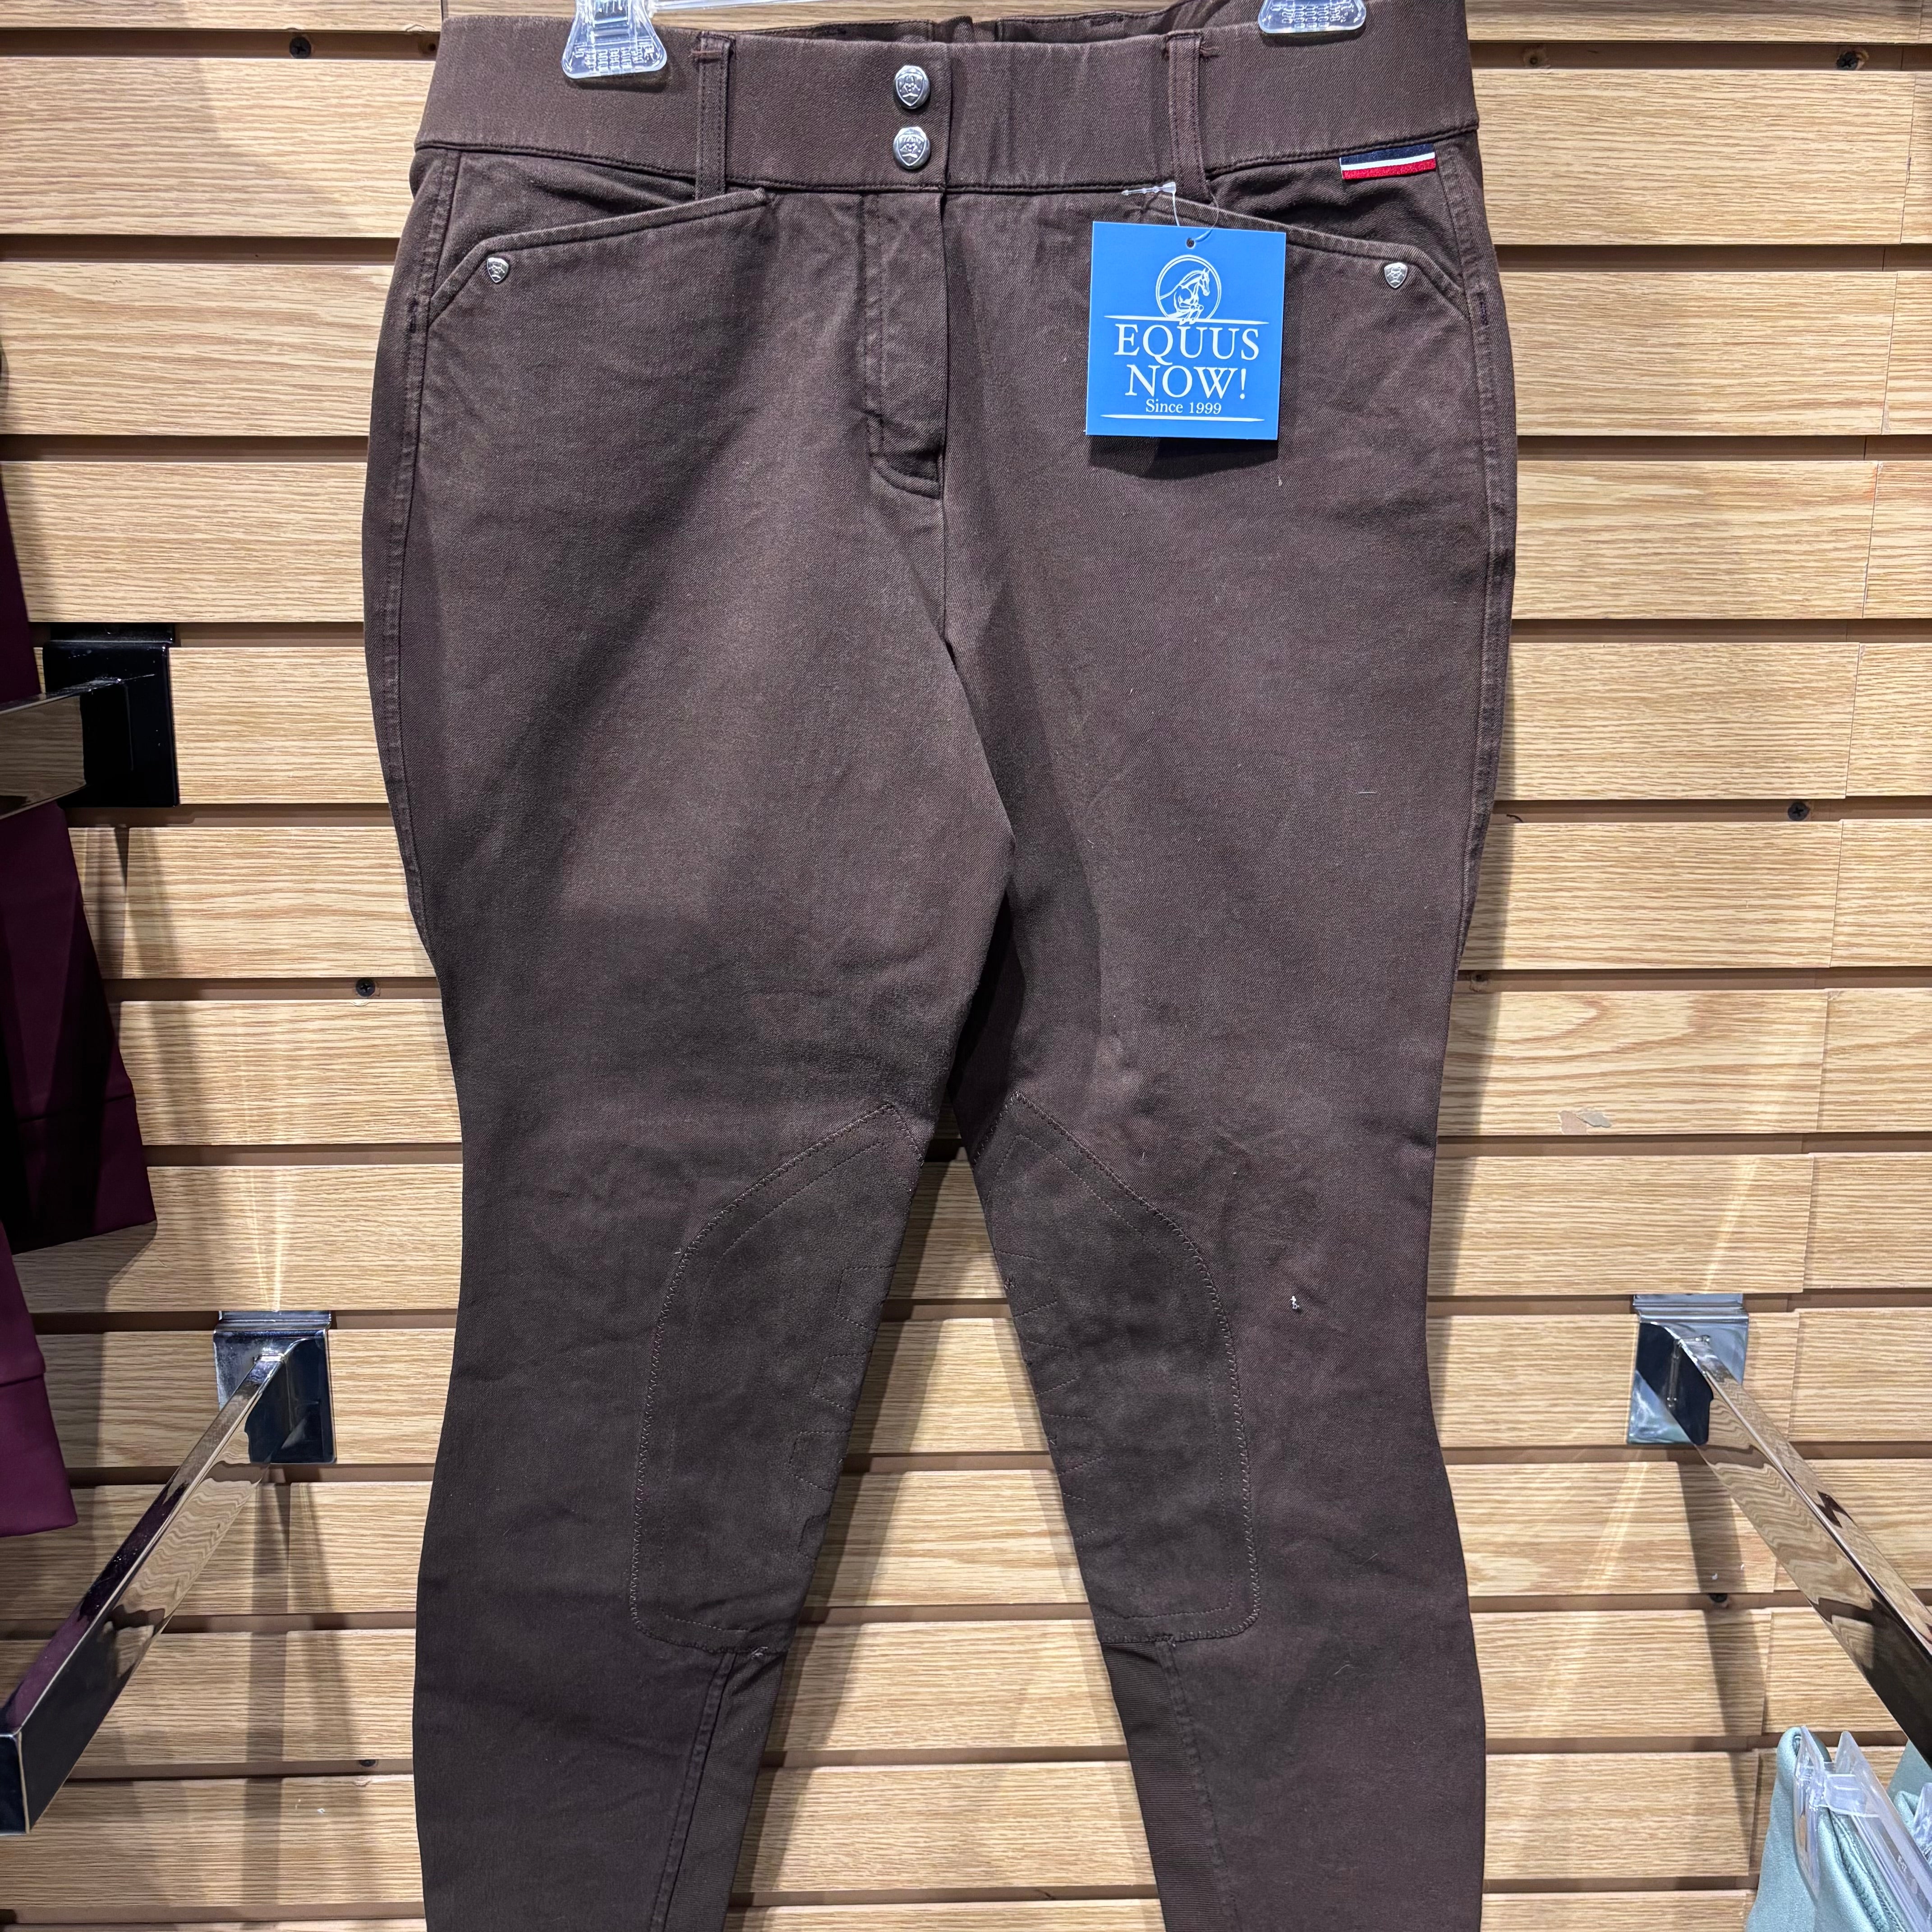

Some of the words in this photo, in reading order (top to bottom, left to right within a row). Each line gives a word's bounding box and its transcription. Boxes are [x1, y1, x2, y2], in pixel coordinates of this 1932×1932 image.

[1114, 323, 1259, 366] EQUUS
[1125, 364, 1247, 400] NOW!
[1145, 399, 1183, 413] Since
[1189, 402, 1222, 414] 1999
